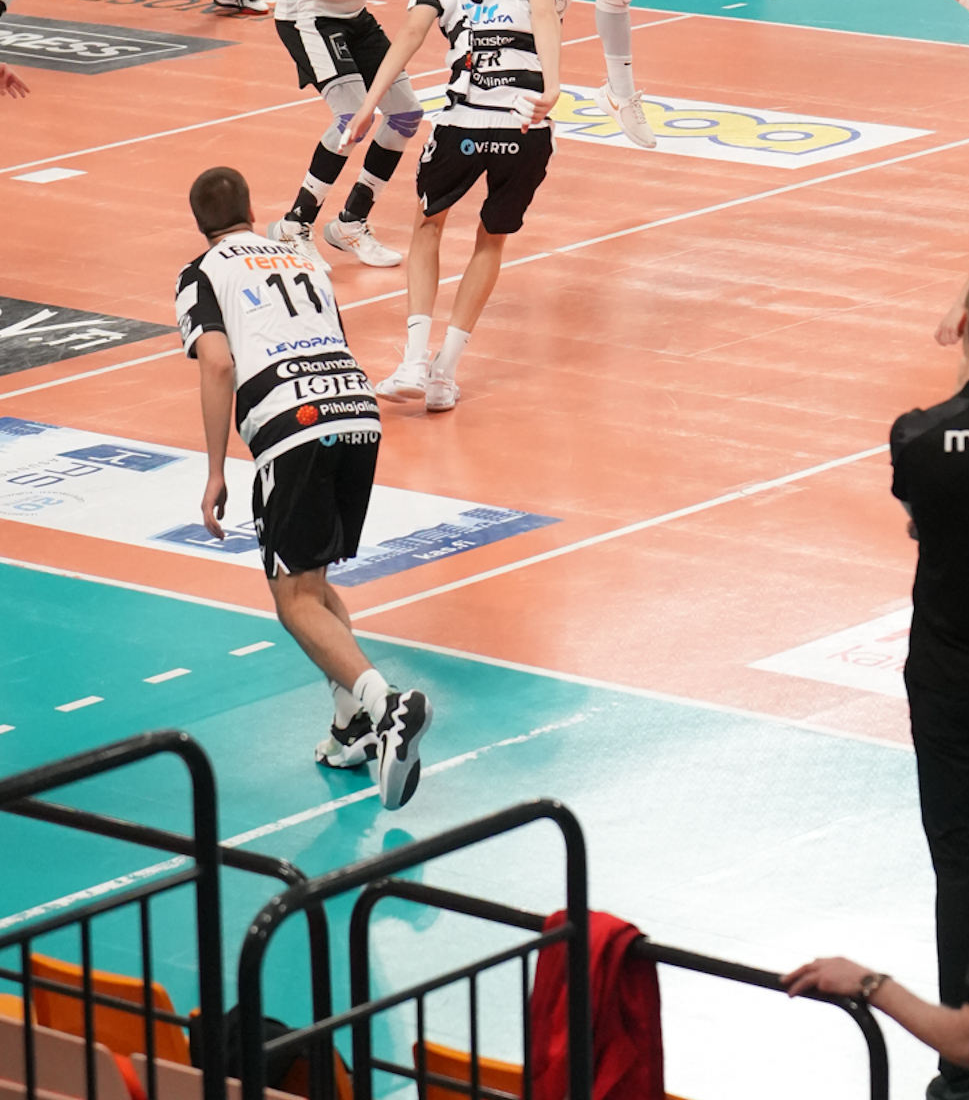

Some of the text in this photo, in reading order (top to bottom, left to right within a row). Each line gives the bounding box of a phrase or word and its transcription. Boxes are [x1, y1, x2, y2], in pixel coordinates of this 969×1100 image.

[0, 29, 142, 58] RESS
[471, 35, 515, 47] master
[218, 245, 299, 260] LEINON
[244, 255, 316, 272] renta
[265, 272, 323, 318] 11
[0, 308, 128, 351] V.fi
[412, 538, 477, 561] kas.fi
